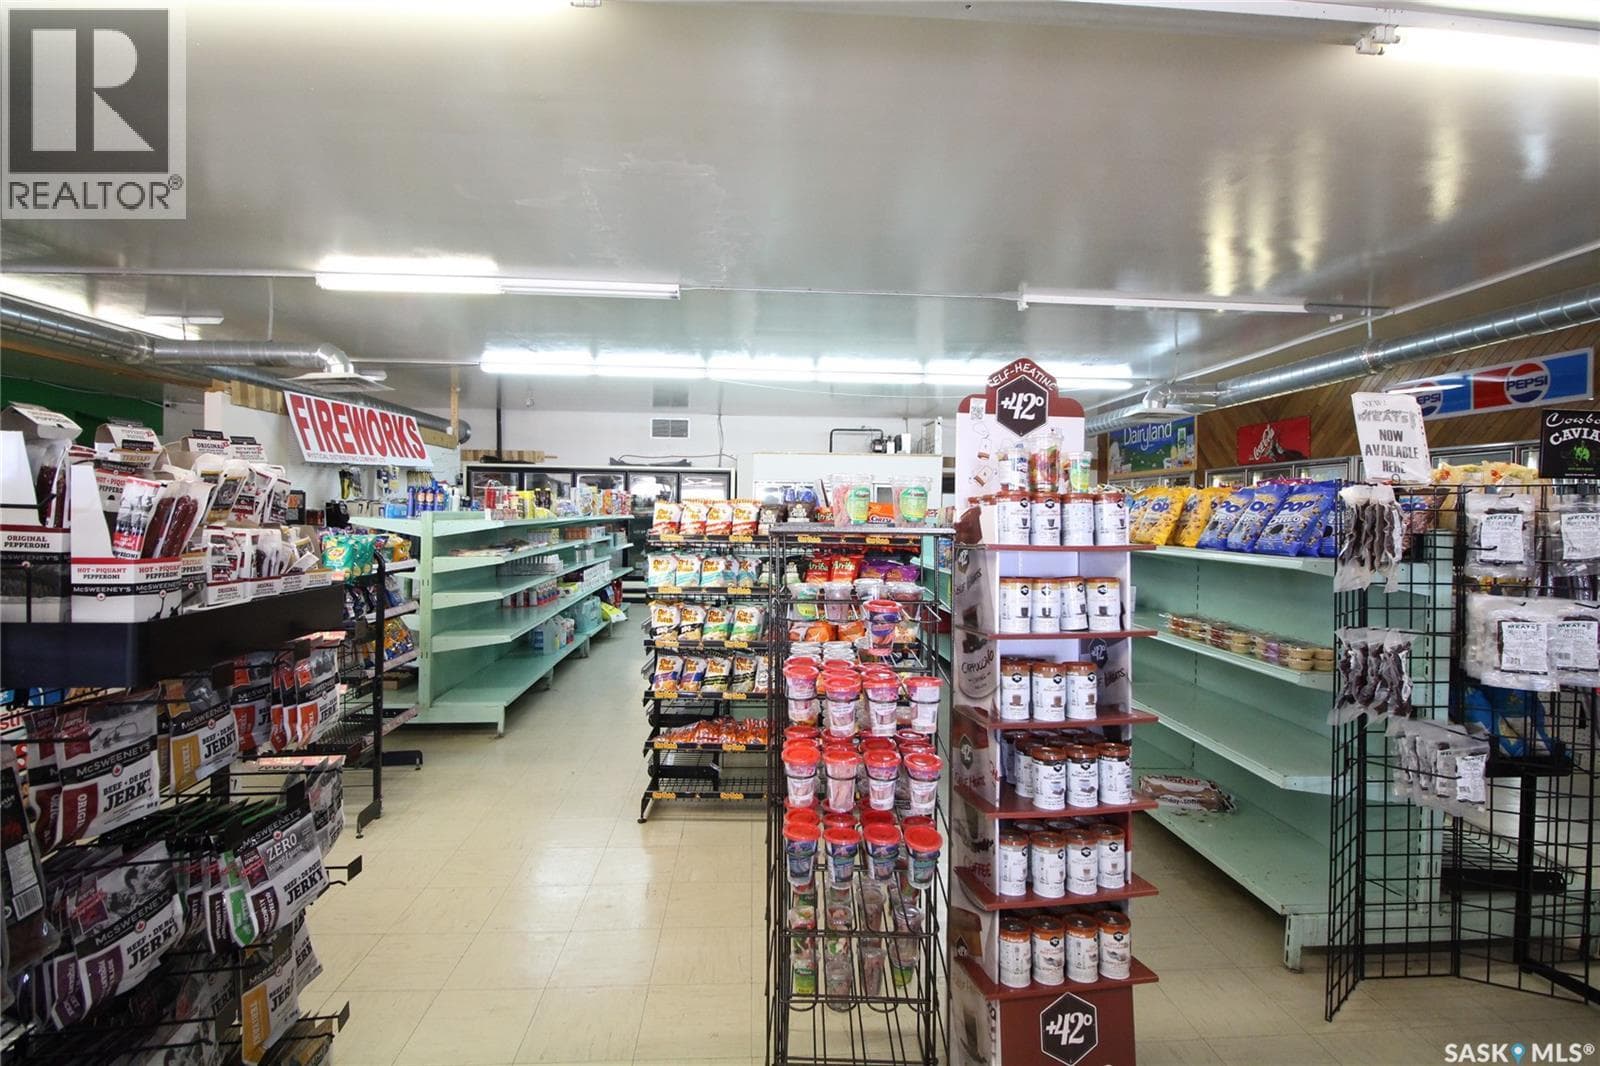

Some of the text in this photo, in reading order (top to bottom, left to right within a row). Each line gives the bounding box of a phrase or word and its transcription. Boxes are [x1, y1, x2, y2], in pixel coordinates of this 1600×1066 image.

[1506, 375, 1549, 391] PEPSI
[1415, 393, 1441, 405] EPSI
[289, 393, 427, 460] FIREWORKS
[1123, 421, 1173, 451] Dairyland
[1378, 429, 1404, 442] NOW
[1365, 444, 1419, 460] AVAILABLE
[1281, 500, 1315, 513] POP
[76, 741, 151, 777] McSWEENEY'S
[103, 781, 122, 796] BEEF
[266, 832, 298, 862] ZERO
[286, 868, 325, 906] JERKY
[127, 935, 147, 954] BEEF
